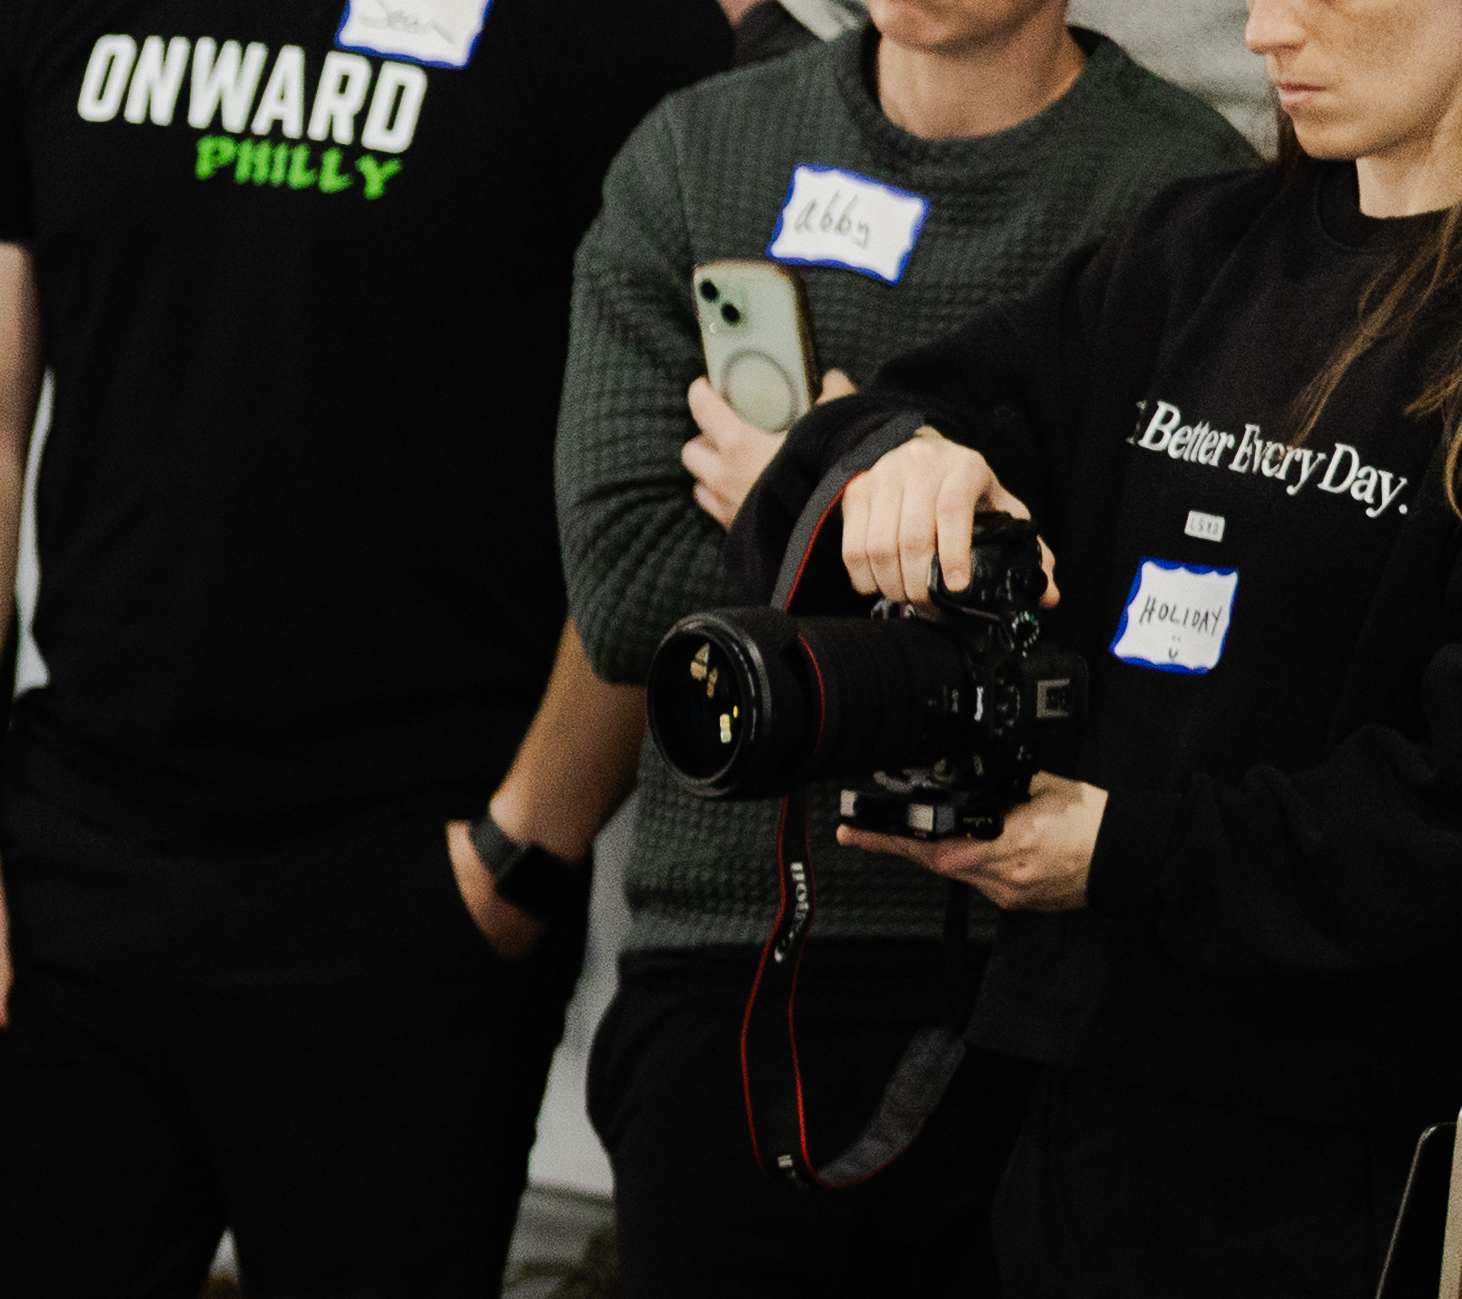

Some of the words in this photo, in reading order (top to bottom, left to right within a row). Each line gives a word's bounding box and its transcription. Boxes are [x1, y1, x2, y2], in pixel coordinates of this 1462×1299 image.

[76, 32, 429, 155] ONWARD
[193, 133, 404, 201] PHILLY
[1138, 399, 1236, 468] Better
[1227, 423, 1328, 497] Every
[1316, 443, 1409, 519] Day.
[1138, 595, 1224, 637] HOLIDAY
